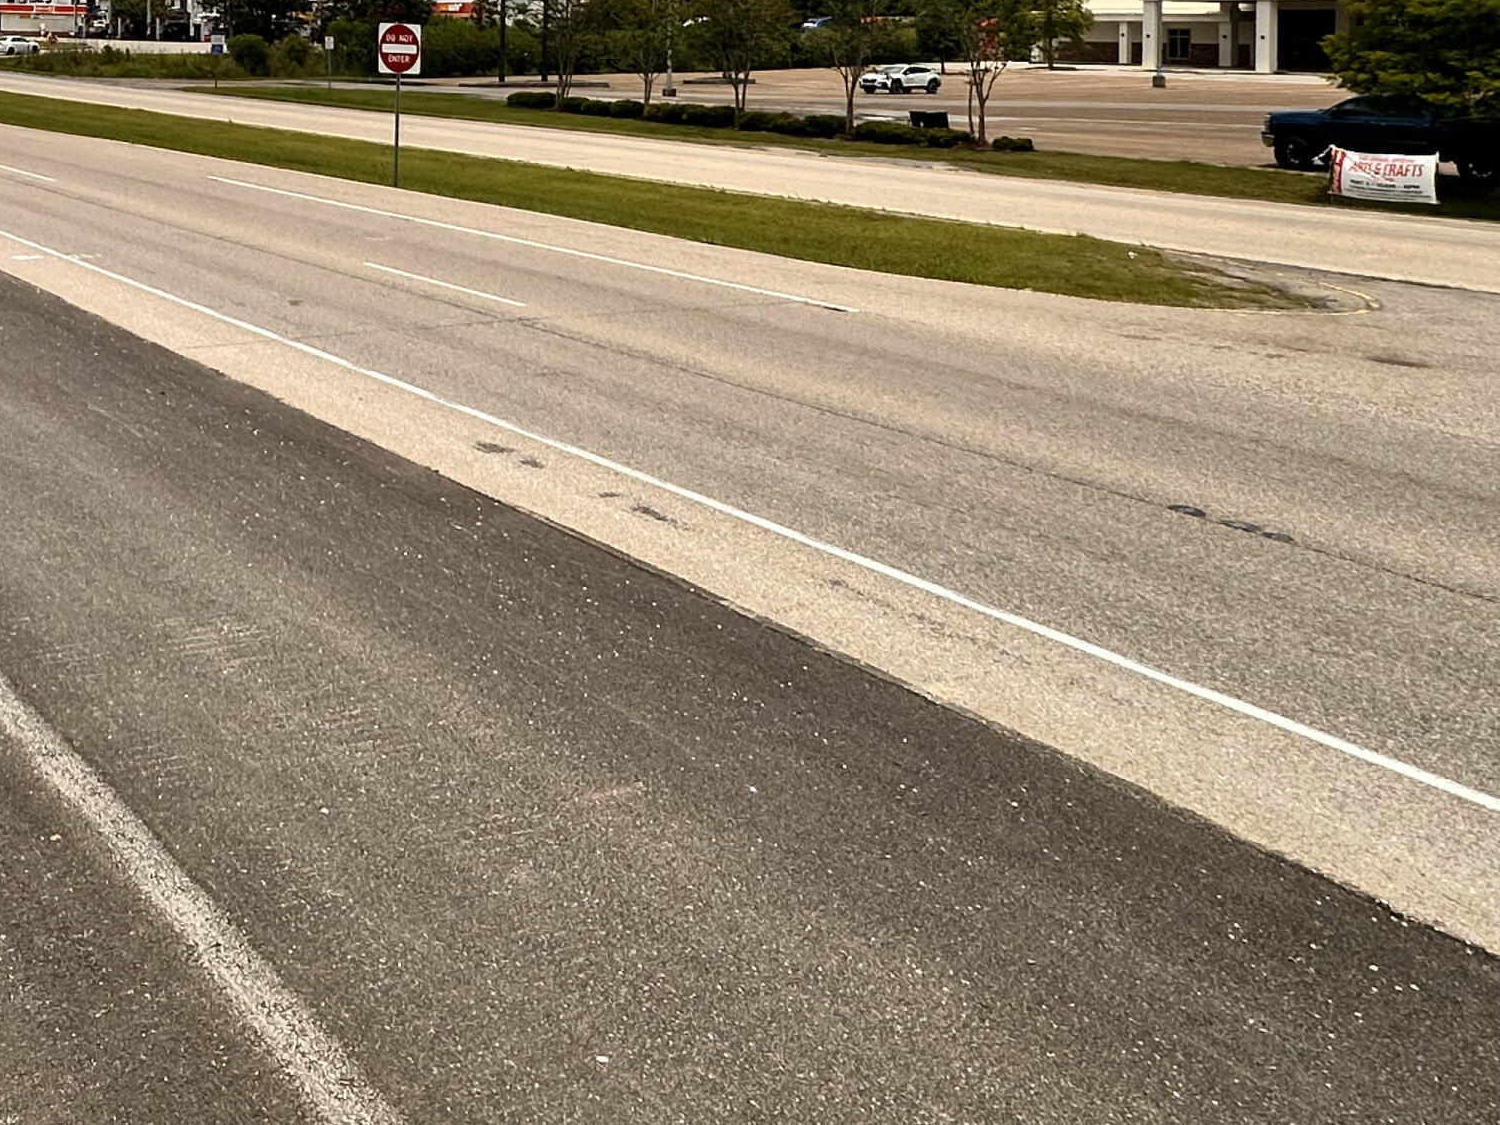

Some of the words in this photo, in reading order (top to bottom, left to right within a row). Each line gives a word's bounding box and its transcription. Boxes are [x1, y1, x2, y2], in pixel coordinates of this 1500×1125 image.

[386, 34, 396, 42] DO
[399, 35, 413, 43] NOT
[388, 55, 410, 63] ENTER
[1384, 163, 1424, 177] CRAFTS
